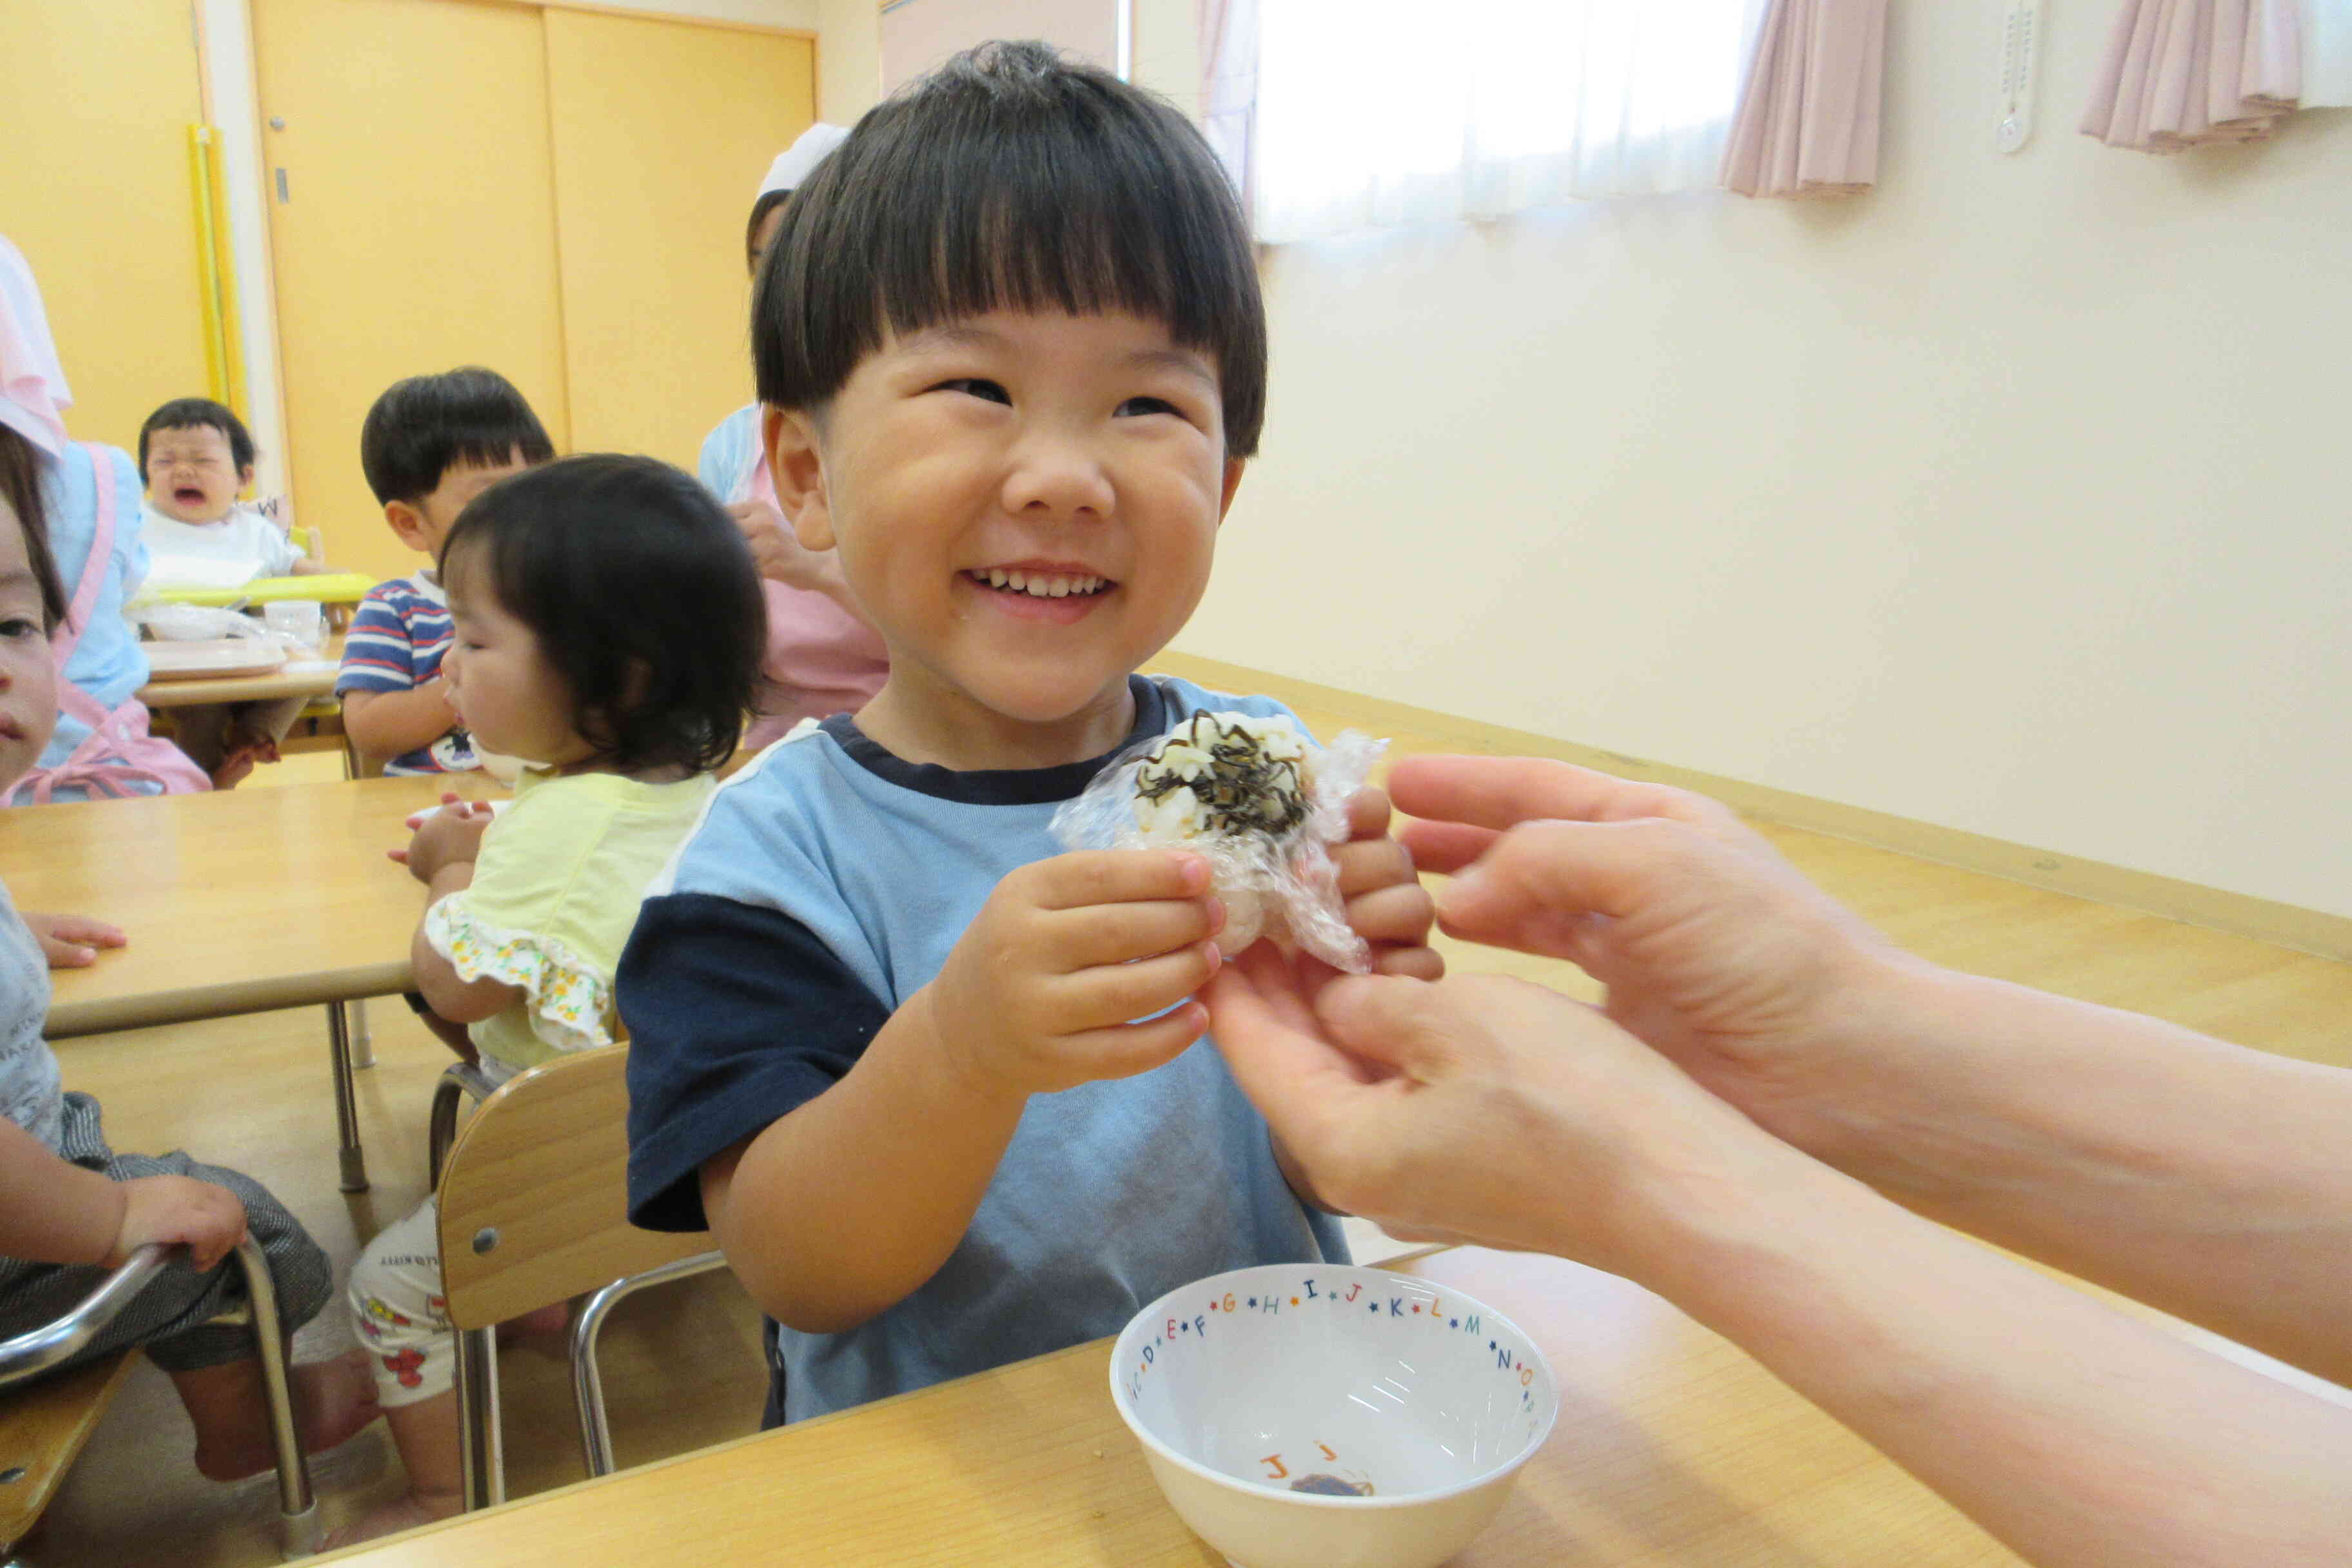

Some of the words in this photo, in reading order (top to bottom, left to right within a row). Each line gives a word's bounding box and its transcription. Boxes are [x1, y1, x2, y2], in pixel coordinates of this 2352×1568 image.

[1142, 1345, 1154, 1364] D
[1166, 1318, 1177, 1340] E
[1194, 1315, 1205, 1338] F
[1222, 1292, 1236, 1313] G
[1262, 1295, 1280, 1315] H
[1303, 1279, 1318, 1299] I
[1346, 1283, 1362, 1302] J
[1390, 1298, 1404, 1317] K
[1431, 1297, 1442, 1317] L
[1464, 1315, 1480, 1336] M
[1498, 1349, 1511, 1369] N
[1520, 1368, 1533, 1386] O
[1259, 1453, 1289, 1480] J
